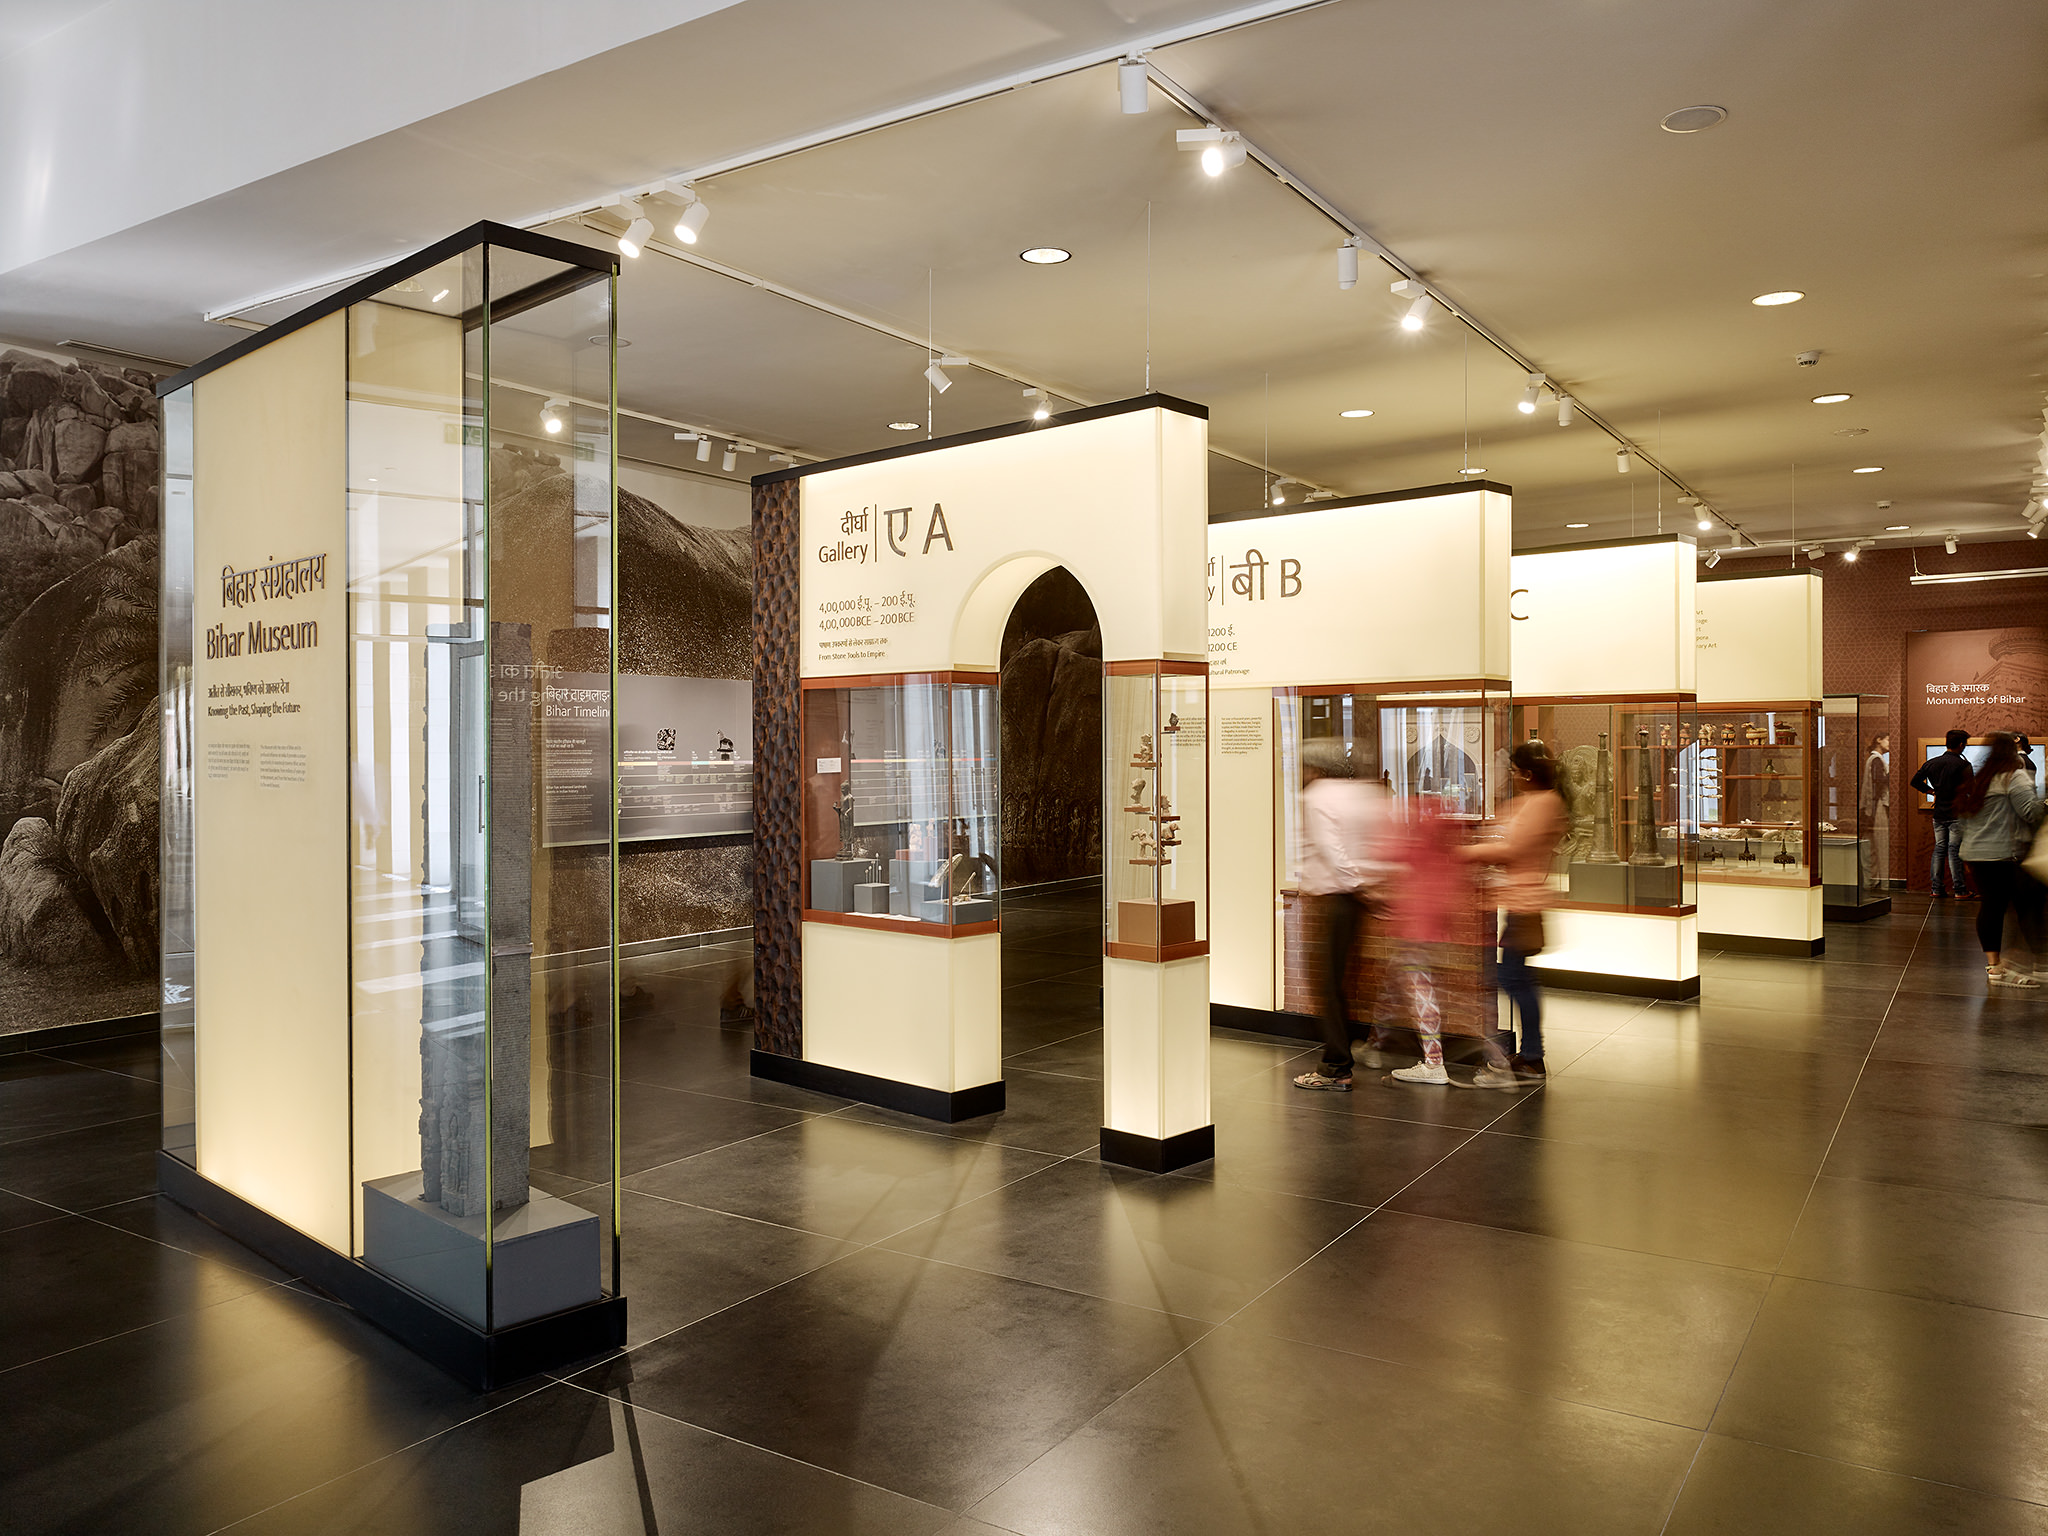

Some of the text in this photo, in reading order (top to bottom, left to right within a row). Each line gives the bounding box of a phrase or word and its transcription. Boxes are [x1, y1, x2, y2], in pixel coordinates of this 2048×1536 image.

[840, 506, 869, 536] दीर्घा
[883, 506, 913, 557] ए
[921, 502, 954, 555] A
[818, 540, 869, 564] Gallery
[221, 553, 327, 608] बिहार संग्रहालय
[1229, 548, 1269, 601] बी
[1280, 558, 1302, 598] B
[818, 599, 856, 614] 4,00,000
[881, 595, 898, 607] 200
[1511, 588, 1529, 621] C
[856, 615, 872, 627] BCE
[880, 613, 897, 625] 200
[898, 611, 915, 624] BCE
[206, 620, 318, 660] Bihar Museum
[1227, 641, 1238, 651] CE
[818, 653, 832, 661] From
[832, 652, 846, 660] Stone
[847, 651, 860, 659] Tools
[867, 649, 885, 659] Empire
[546, 685, 568, 701] बिहार
[1926, 682, 1990, 694] बिहार के स्मारक
[207, 701, 301, 719] Knowing the Past, Shaping the Future
[1926, 694, 2026, 705] Monuments of Bihar
[546, 705, 571, 717] Bihar
